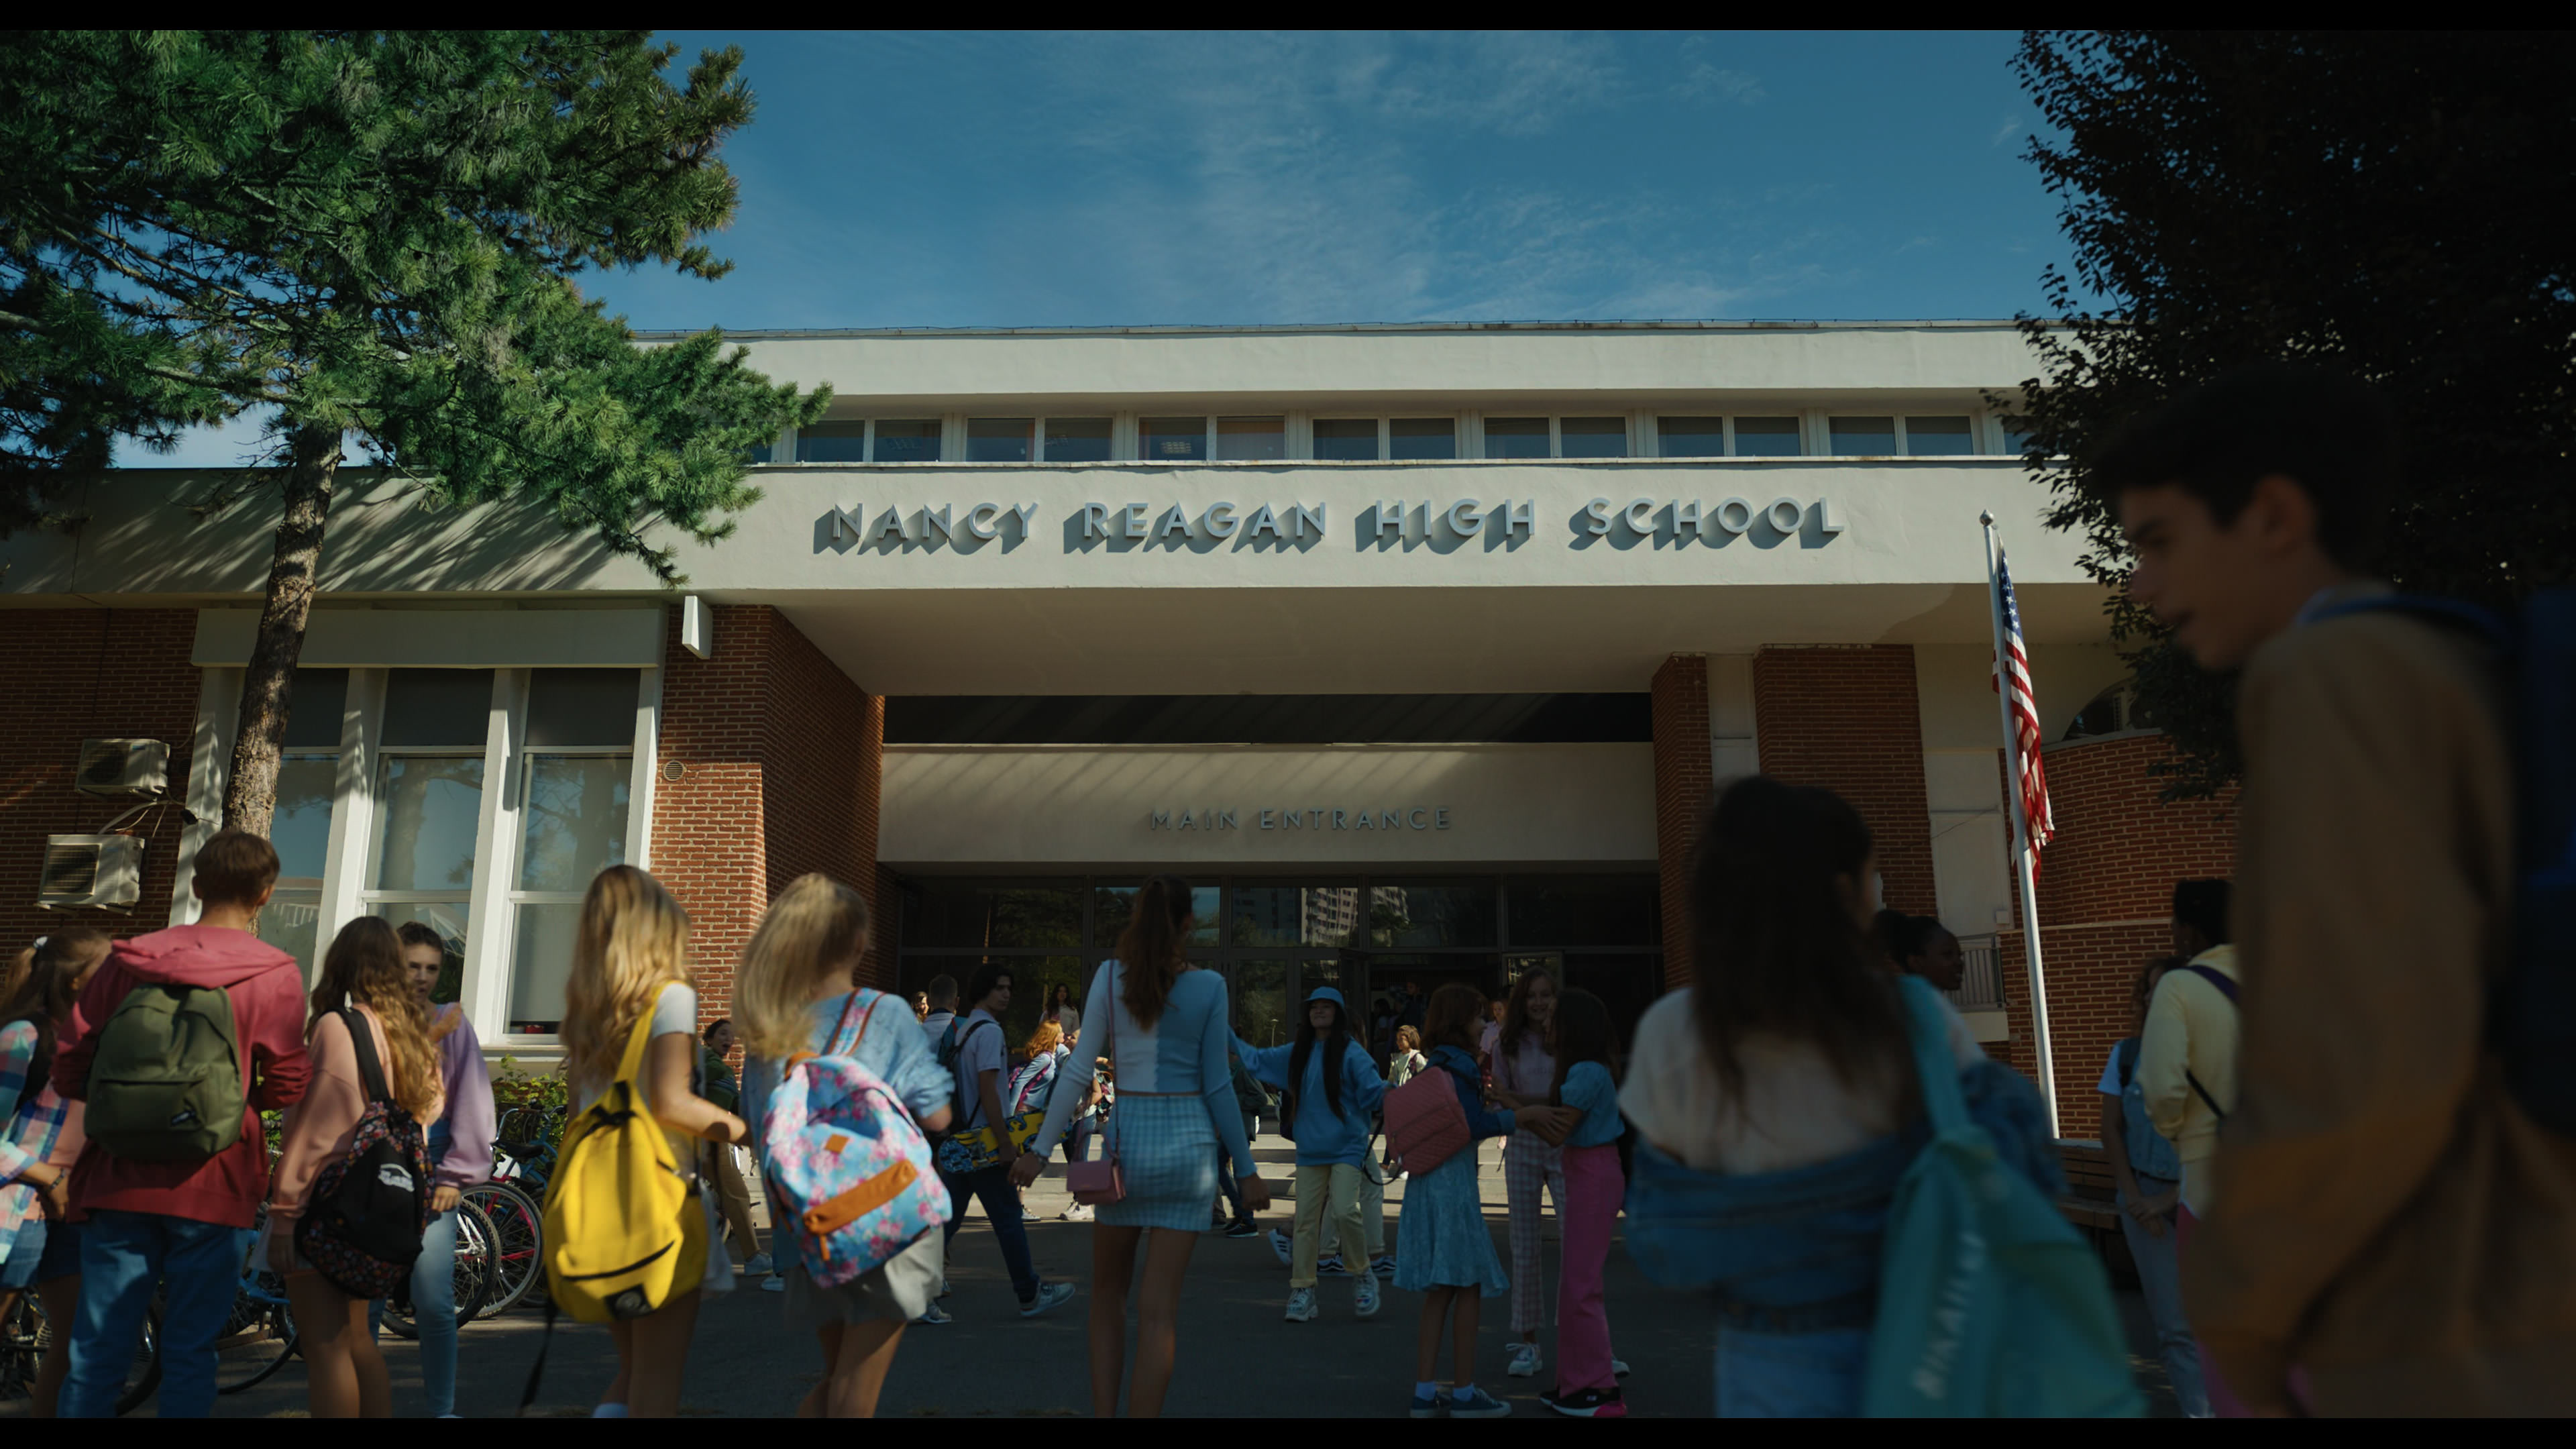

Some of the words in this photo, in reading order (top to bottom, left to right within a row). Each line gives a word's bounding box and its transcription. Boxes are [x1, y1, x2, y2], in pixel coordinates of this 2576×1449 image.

[833, 502, 1038, 539] NANCY
[1085, 501, 1326, 538] REAGAN
[1375, 498, 1535, 537] HIGH
[1587, 496, 1845, 535] SCHOOL
[1151, 808, 1238, 830] MAIN
[1260, 808, 1451, 830] ENTRANCE
